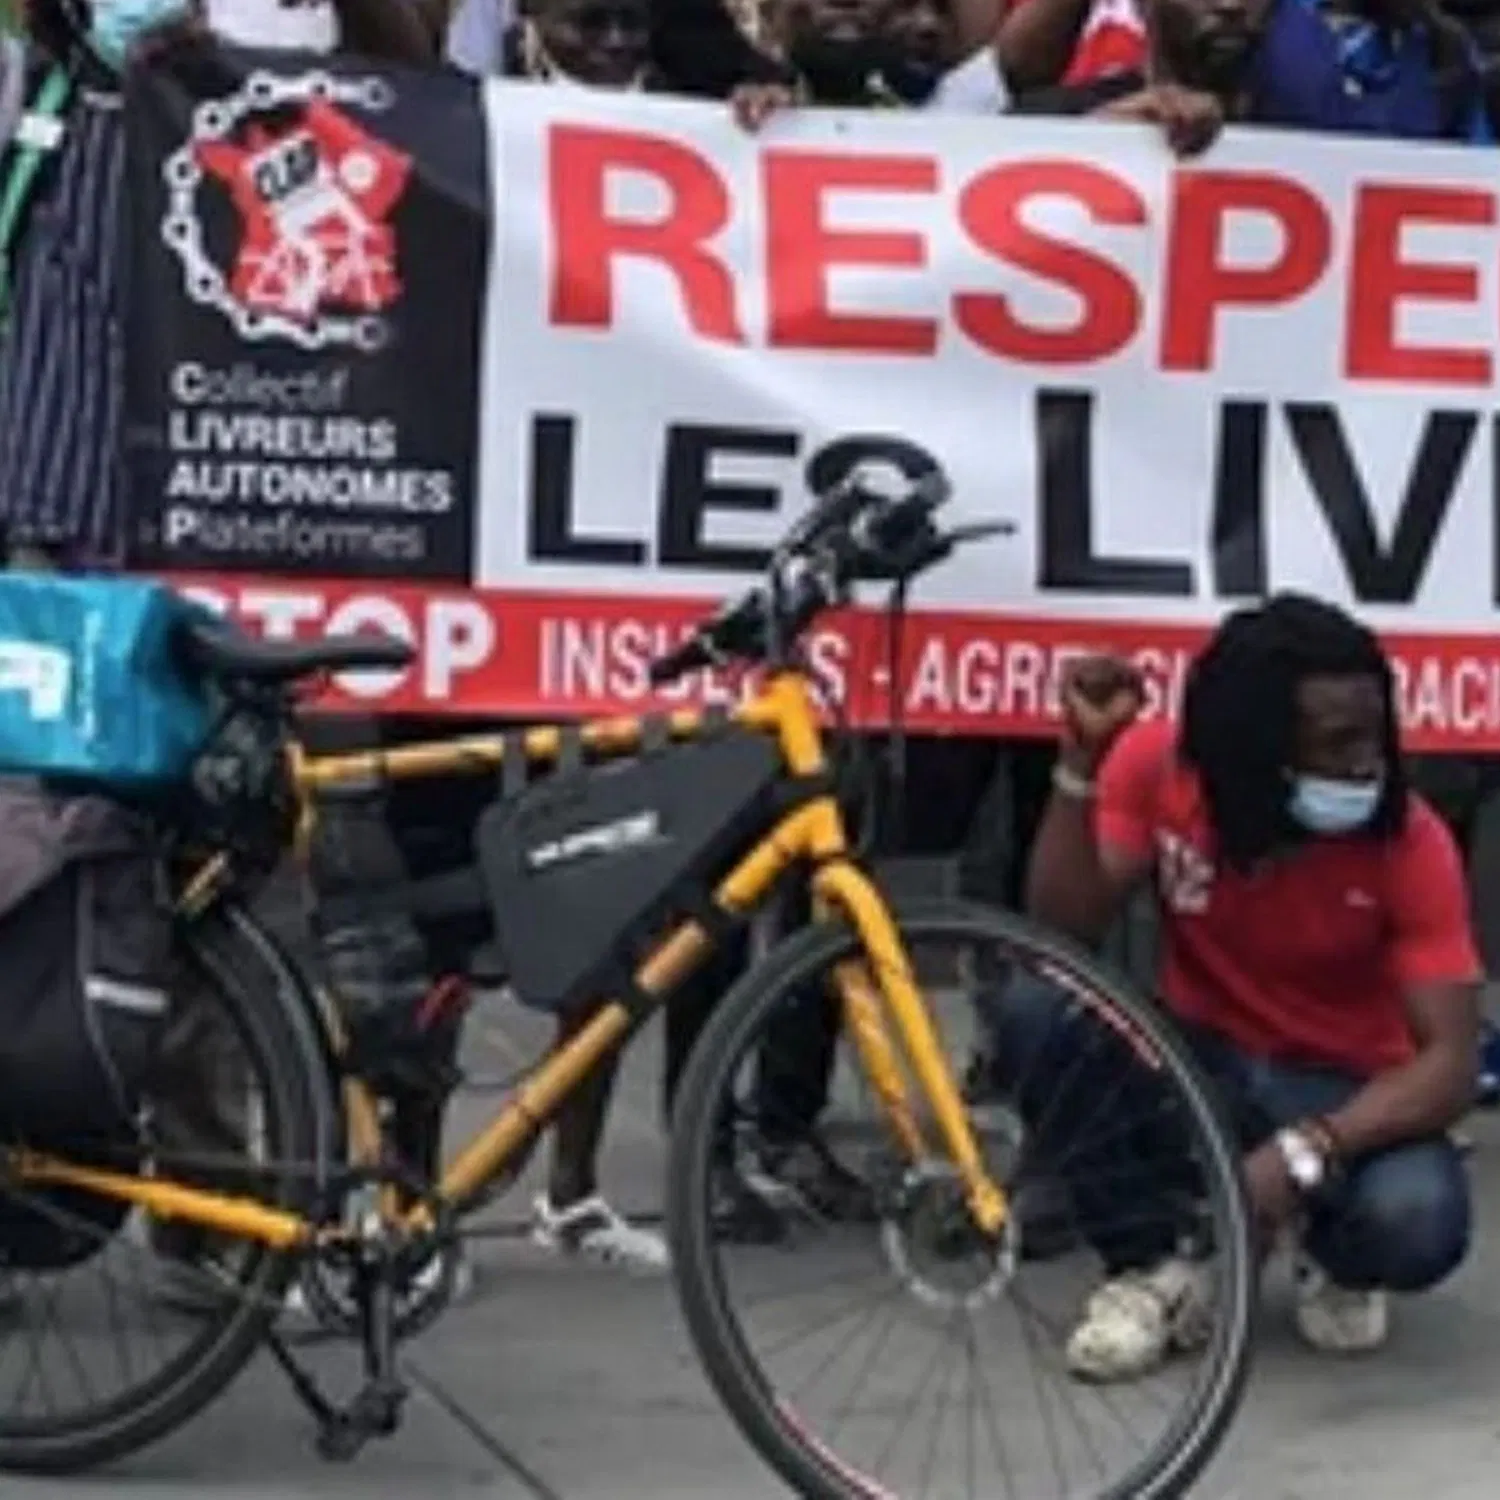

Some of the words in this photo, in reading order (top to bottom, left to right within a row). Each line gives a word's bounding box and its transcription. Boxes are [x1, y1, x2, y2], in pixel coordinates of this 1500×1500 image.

[168, 409, 397, 459] LIVREURS
[166, 457, 453, 513] AUTONOMES
[178, 585, 498, 699] TOP
